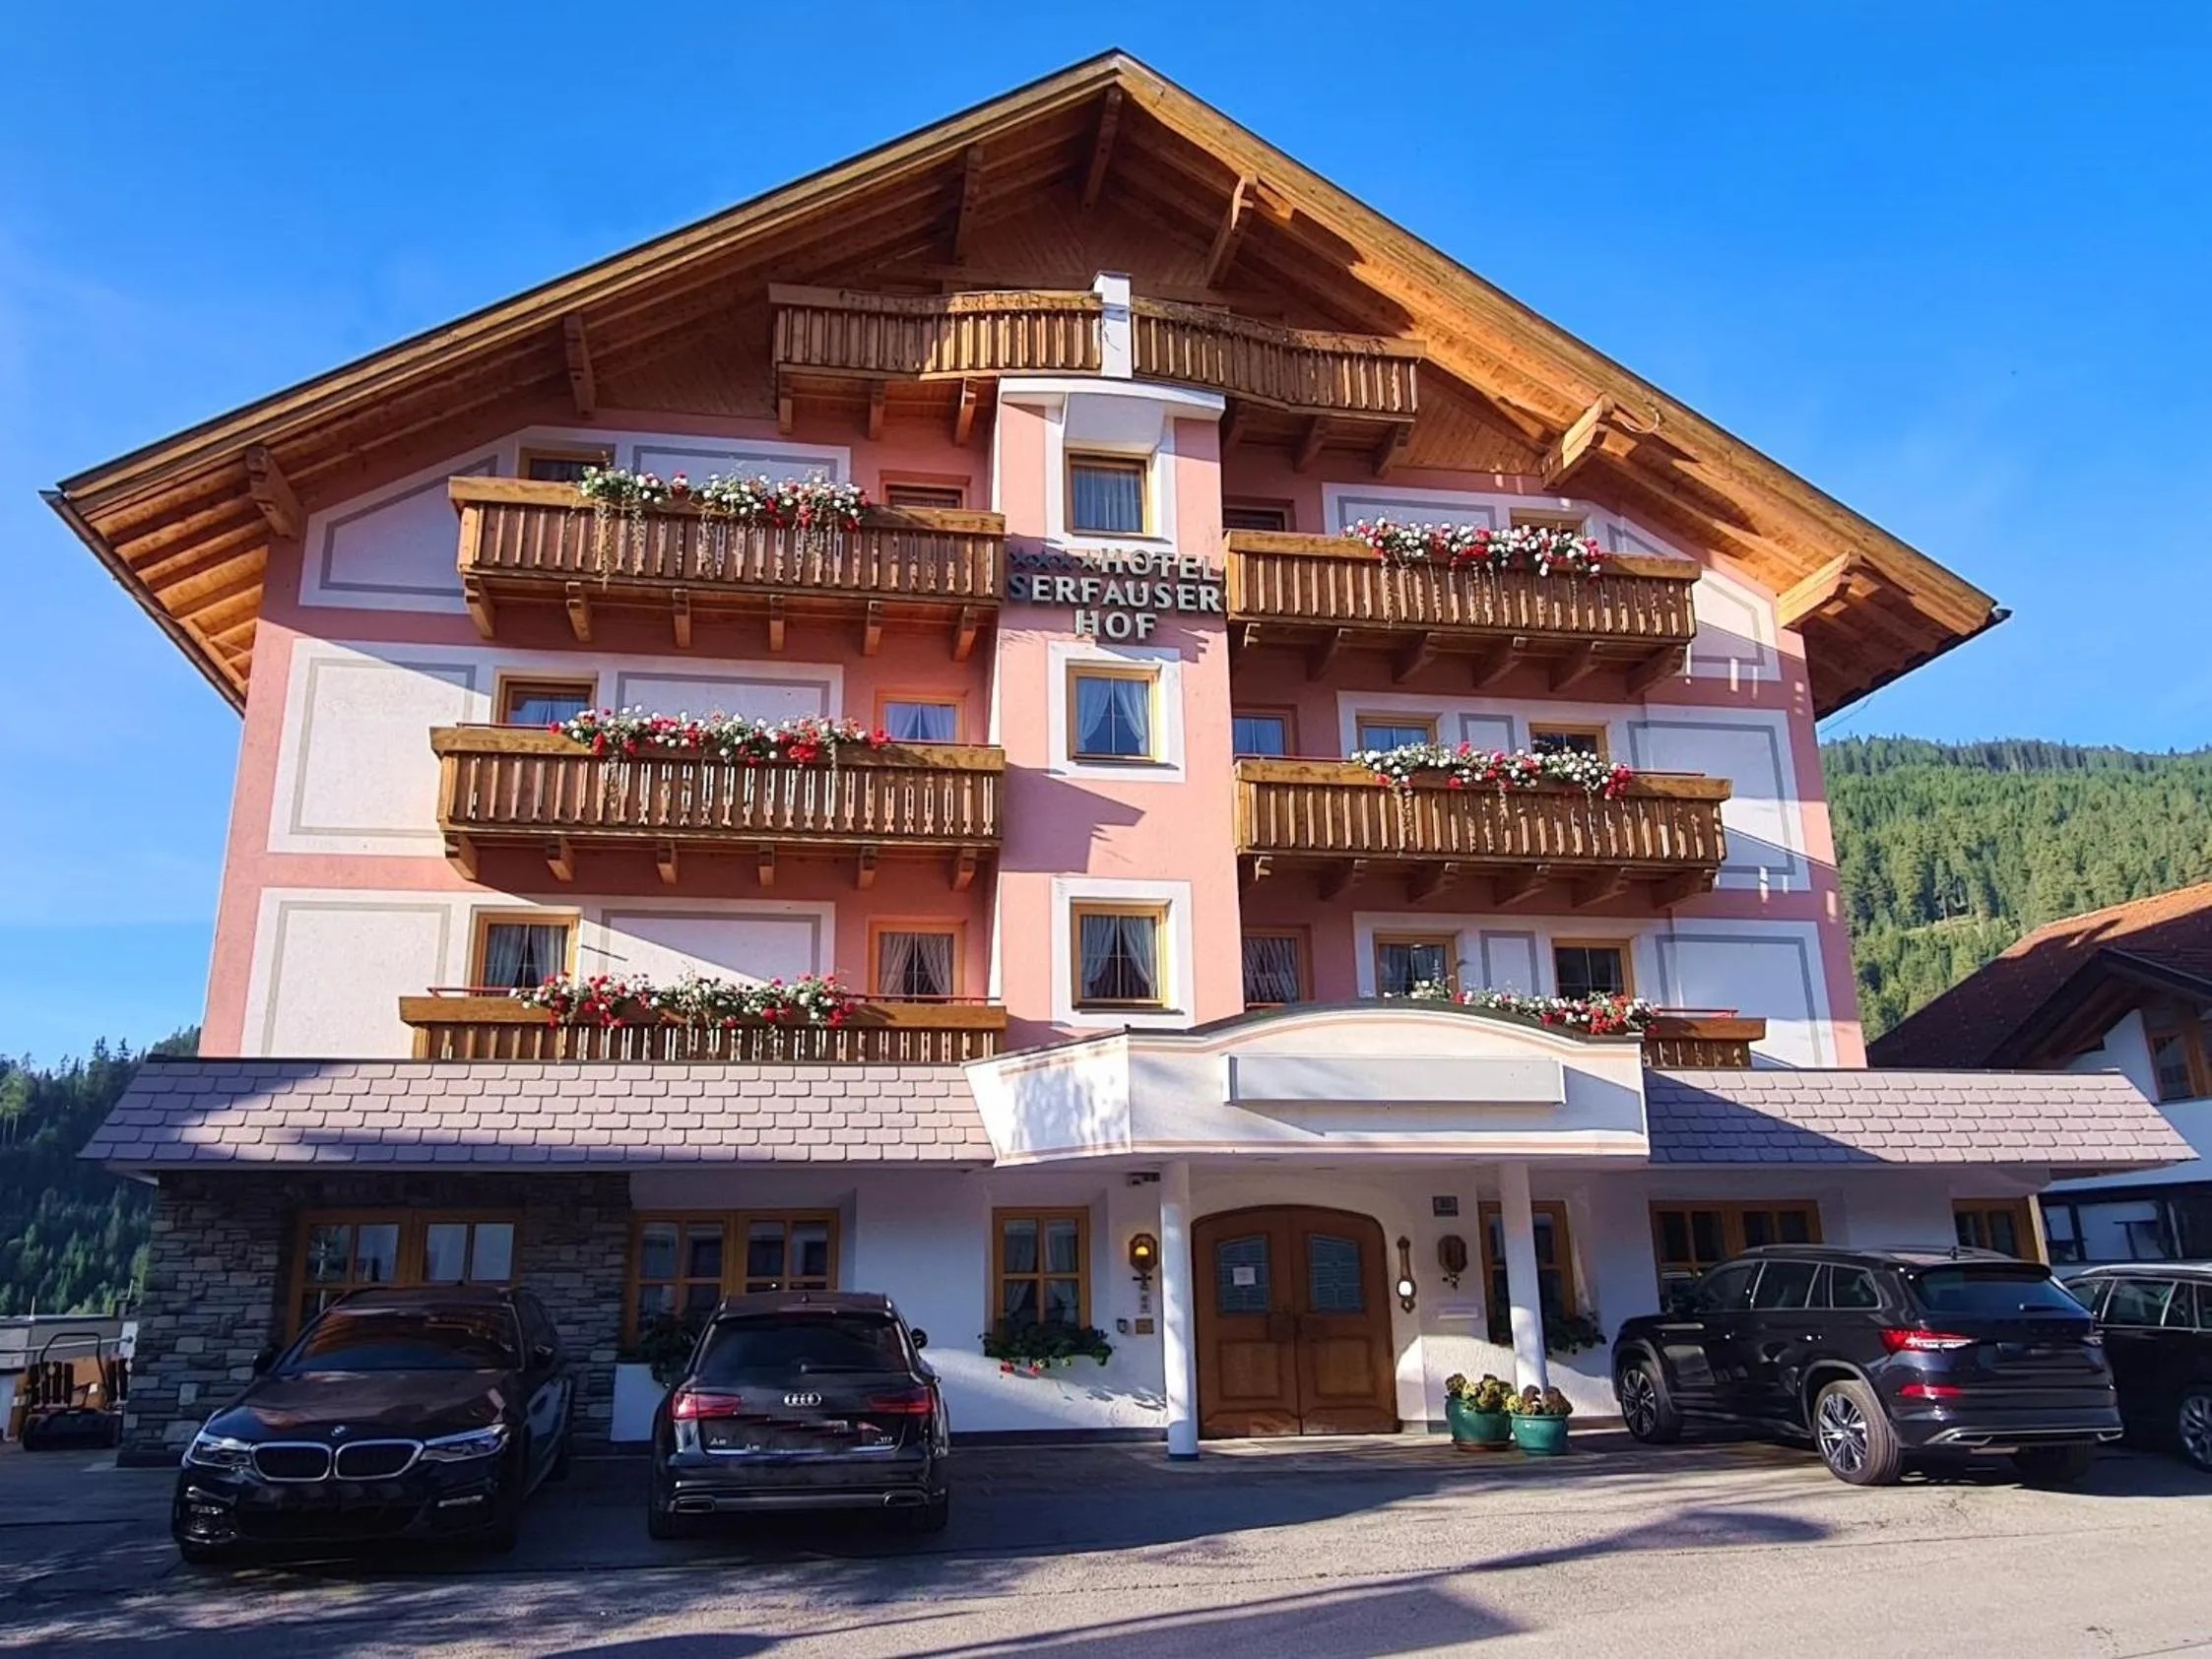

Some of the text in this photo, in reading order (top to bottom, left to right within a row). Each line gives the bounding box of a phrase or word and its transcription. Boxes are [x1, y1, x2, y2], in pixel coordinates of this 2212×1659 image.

[1100, 547, 1222, 582] HOTEL
[1008, 573, 1222, 612] SERFAUSER
[1074, 608, 1158, 639] HOF
